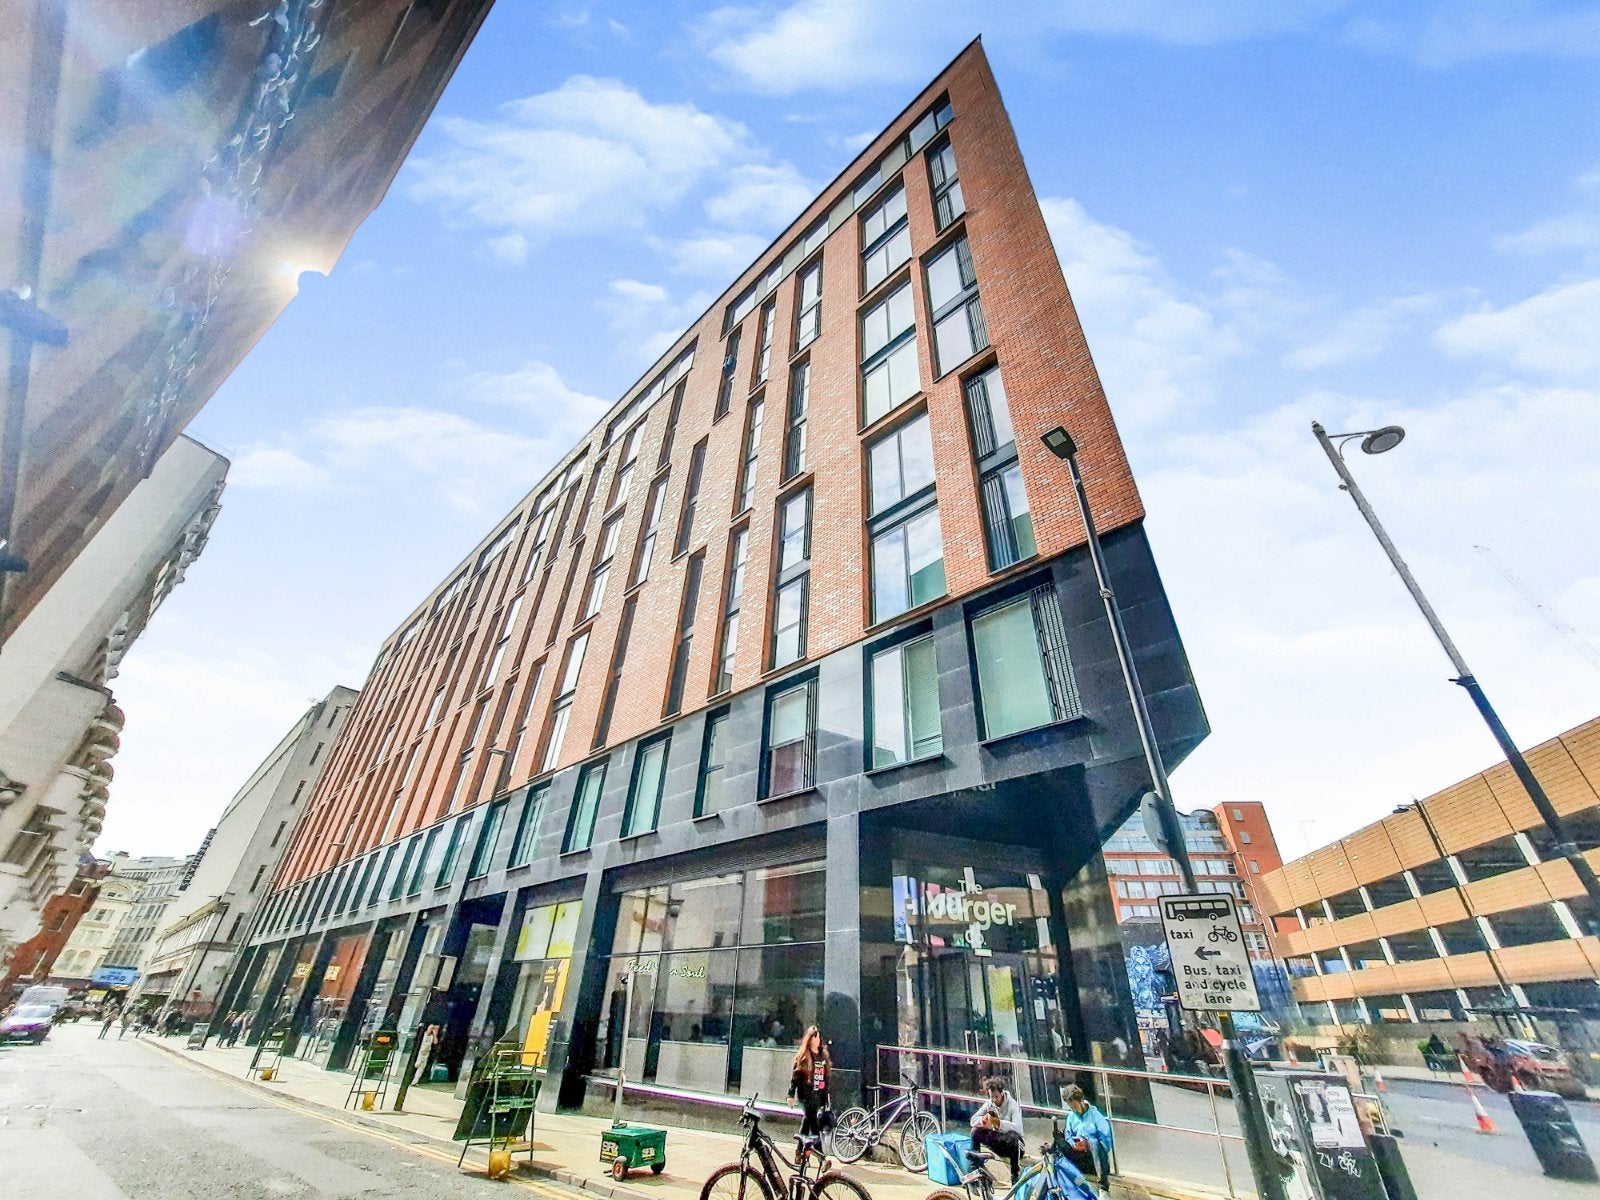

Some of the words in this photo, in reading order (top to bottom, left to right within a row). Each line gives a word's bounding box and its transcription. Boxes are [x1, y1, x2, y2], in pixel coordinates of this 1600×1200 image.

[1170, 929, 1194, 940] taxi
[627, 959, 652, 974] Feed
[681, 966, 706, 978] Soul
[1216, 964, 1241, 976] taxi
[1185, 979, 1208, 990] and
[1212, 979, 1247, 991] cycle
[1204, 994, 1232, 1004] lane
